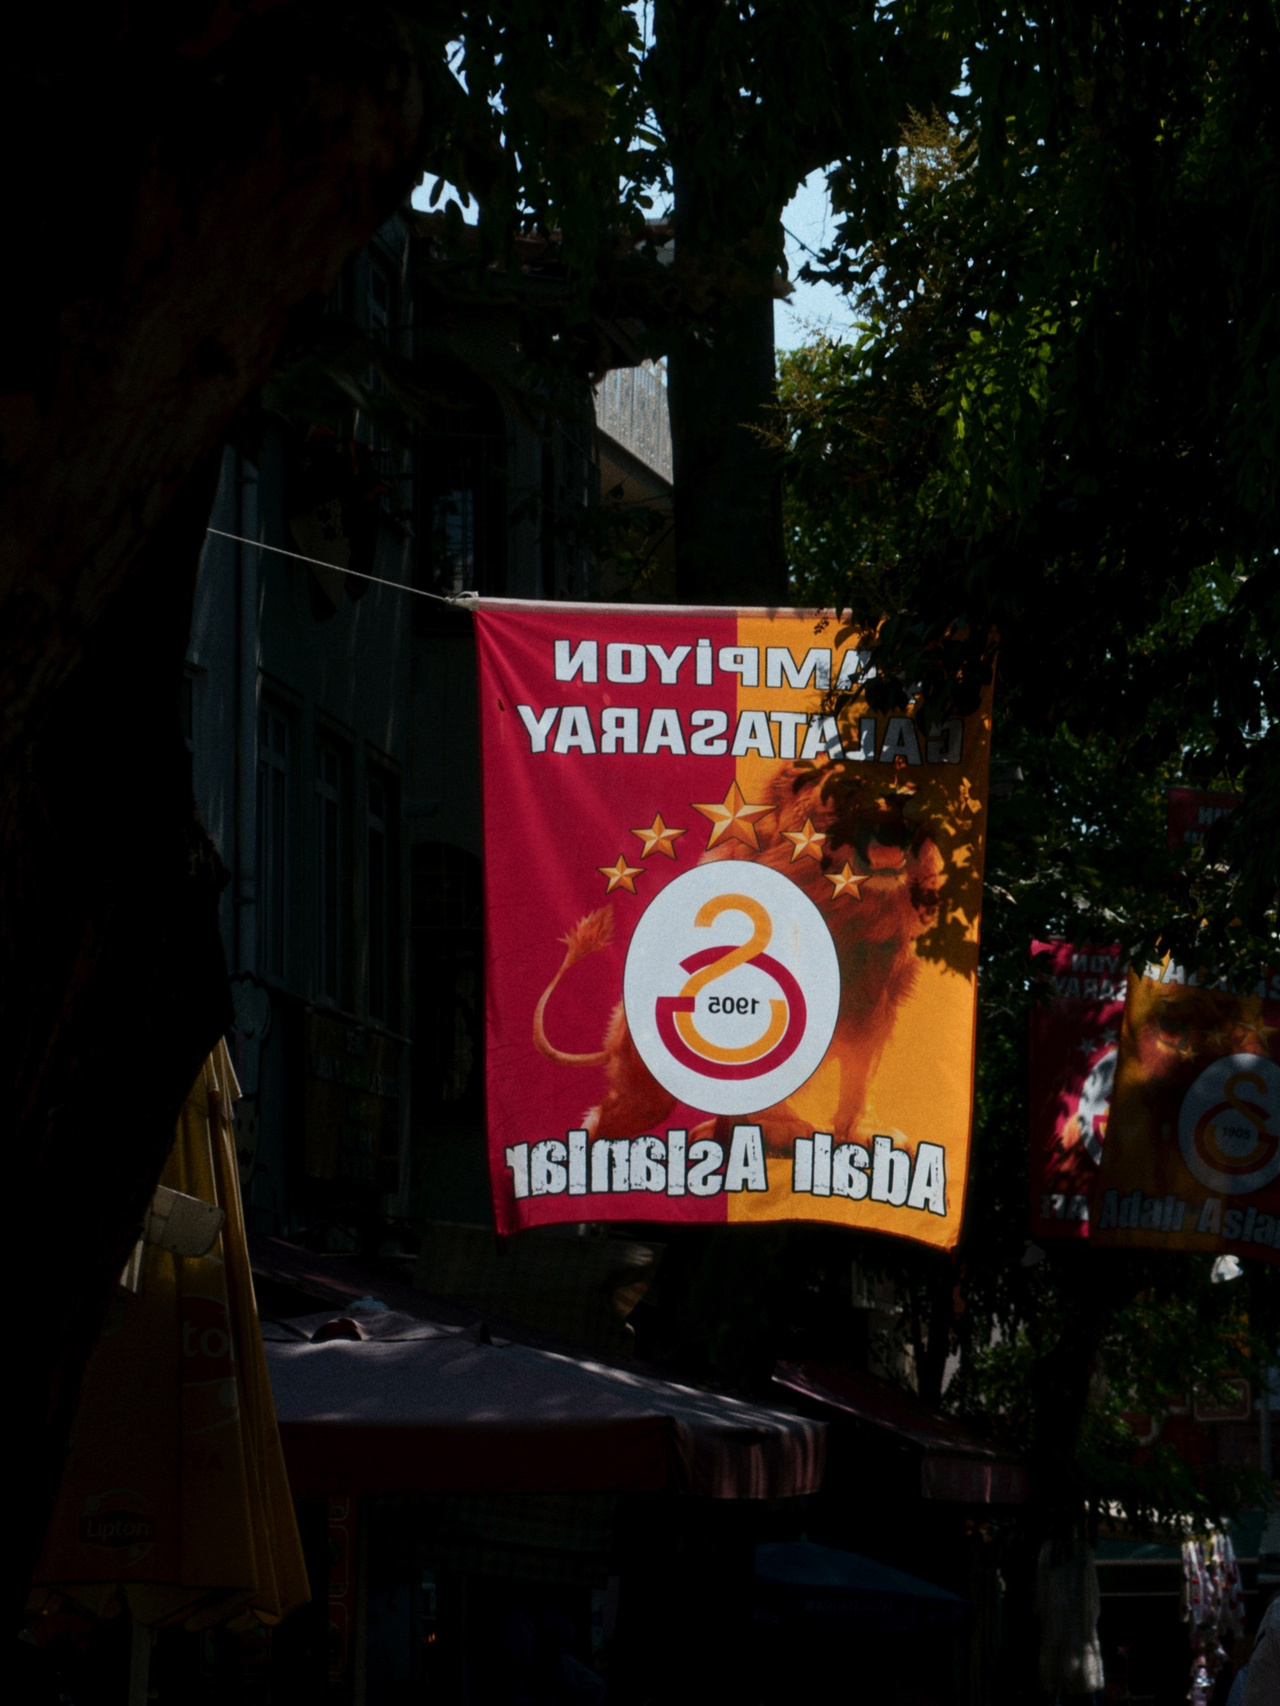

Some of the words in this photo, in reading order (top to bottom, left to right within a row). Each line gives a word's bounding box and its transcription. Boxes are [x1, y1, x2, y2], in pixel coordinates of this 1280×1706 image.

[1222, 1126, 1251, 1140] 1905
[1097, 1187, 1187, 1233] Adalı
[85, 1517, 150, 1541] Lipton
